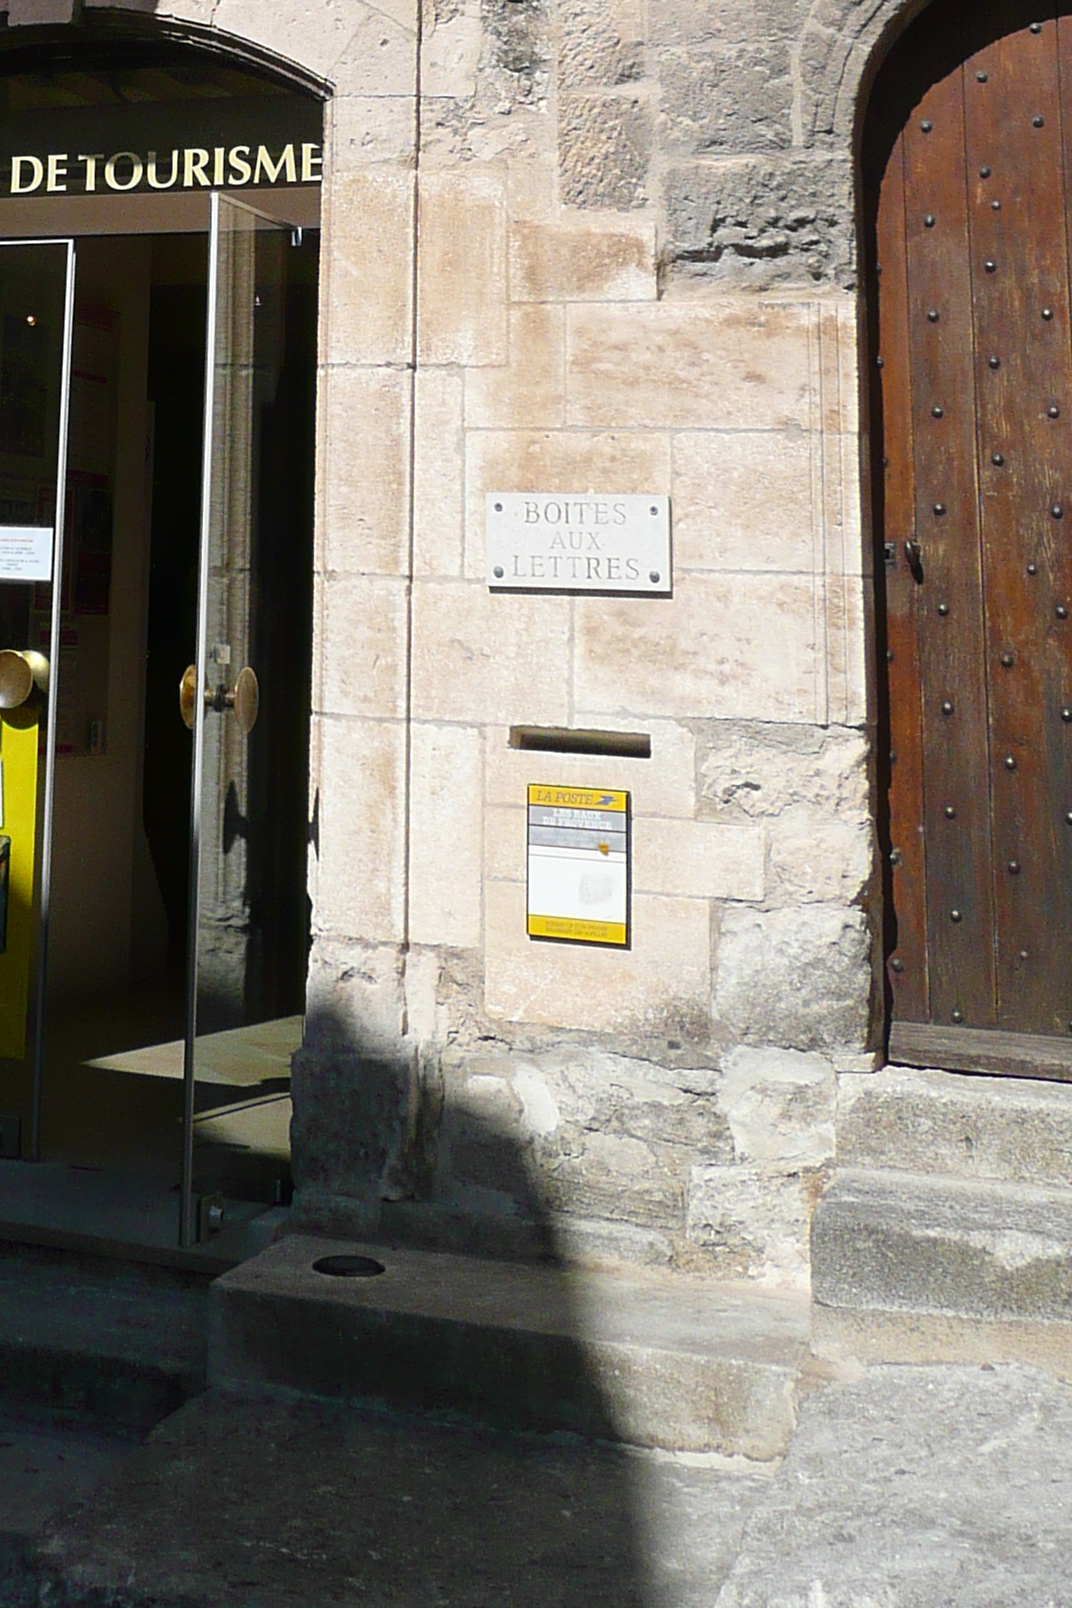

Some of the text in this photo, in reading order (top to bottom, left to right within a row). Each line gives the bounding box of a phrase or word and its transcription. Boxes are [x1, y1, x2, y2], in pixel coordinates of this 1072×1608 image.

[10, 153, 68, 194] DE
[77, 142, 323, 192] TOURISME
[523, 501, 627, 526] BOITES
[549, 531, 603, 551] AUX
[512, 555, 641, 581] LETTRES
[536, 790, 594, 805] LA POSTE
[542, 815, 612, 830] DE PROVENCE
[553, 808, 573, 818] LES
